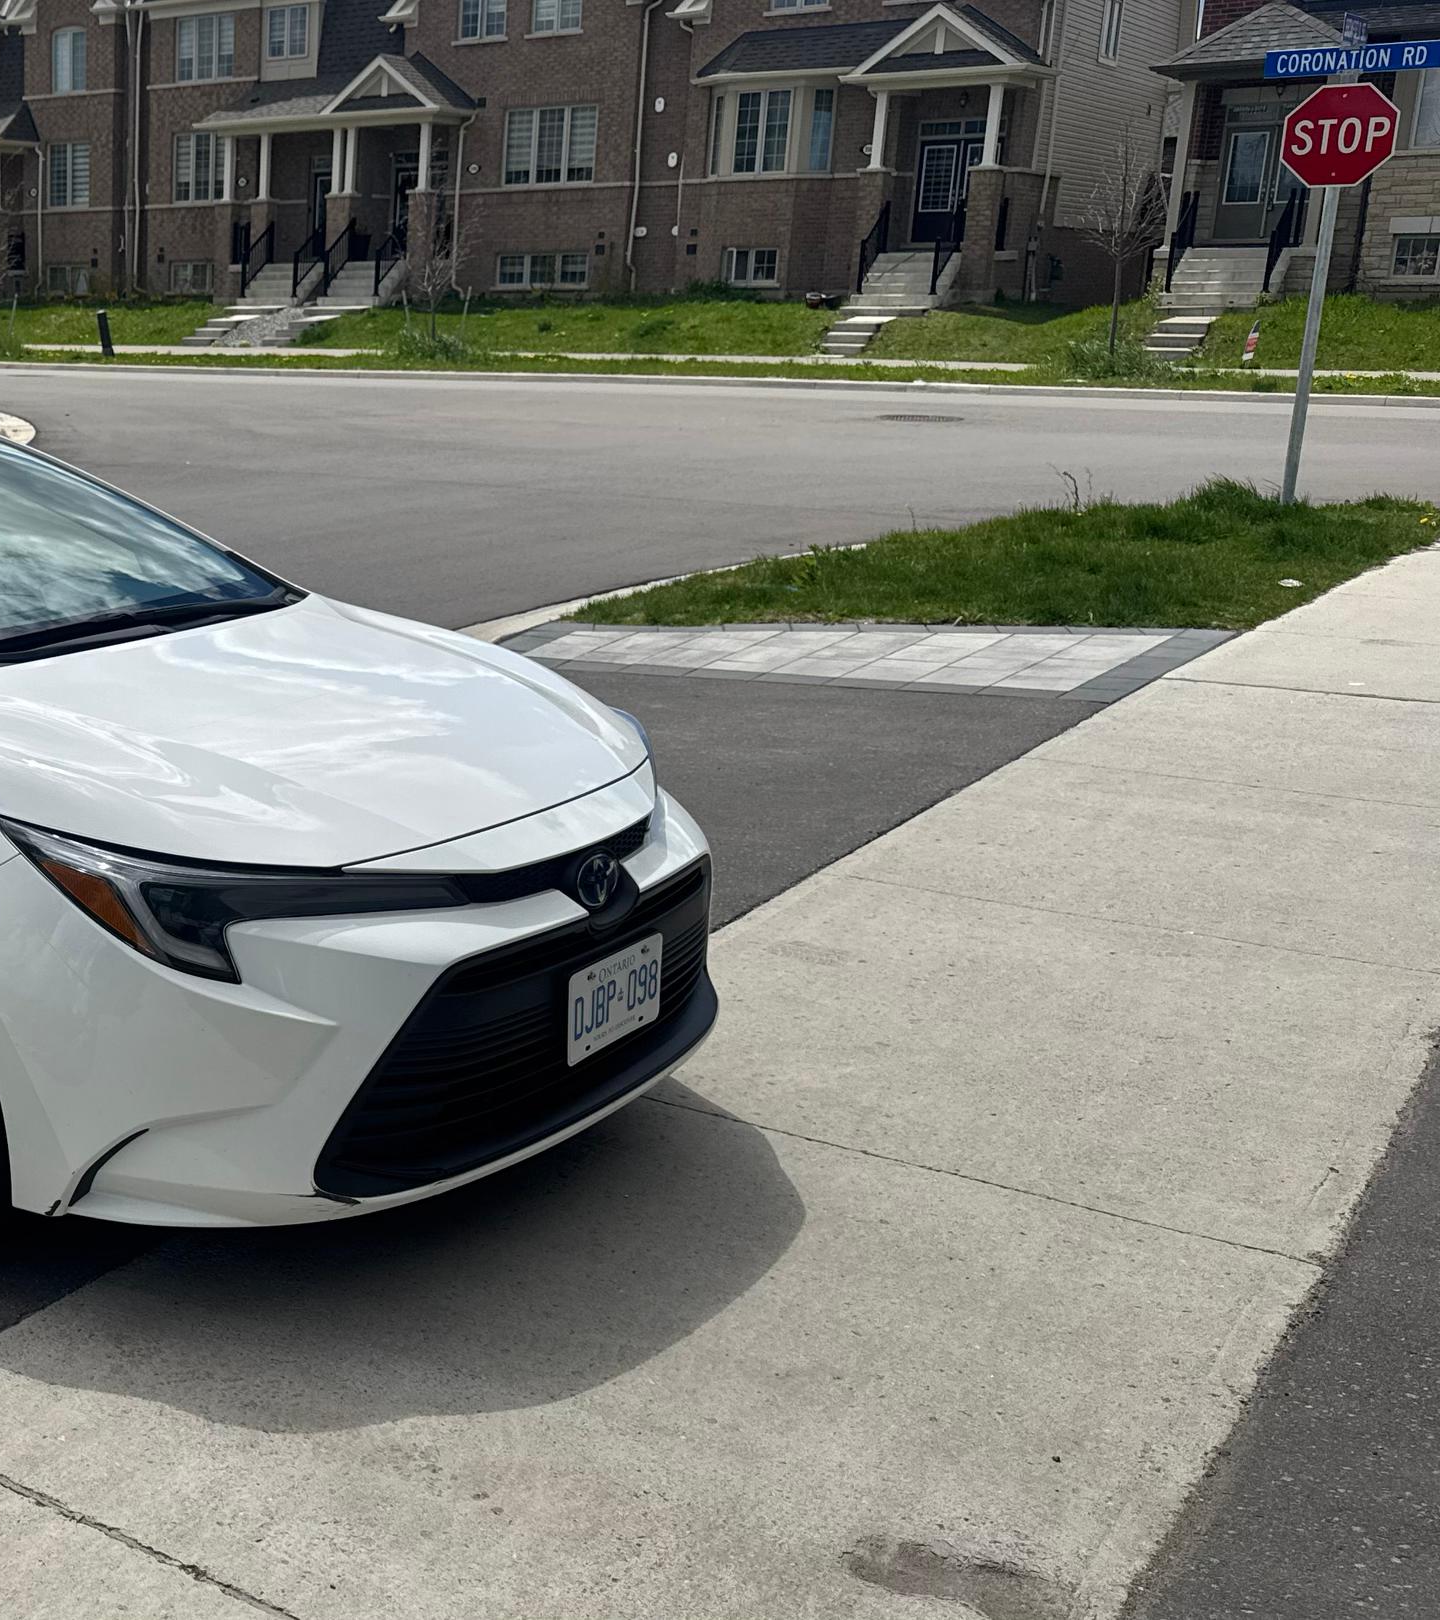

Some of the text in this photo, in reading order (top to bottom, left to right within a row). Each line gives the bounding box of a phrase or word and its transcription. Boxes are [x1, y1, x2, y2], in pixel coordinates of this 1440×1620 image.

[1276, 46, 1428, 74] CORONATION RD
[1291, 116, 1391, 156] STOP
[598, 954, 636, 983] ONTARIO
